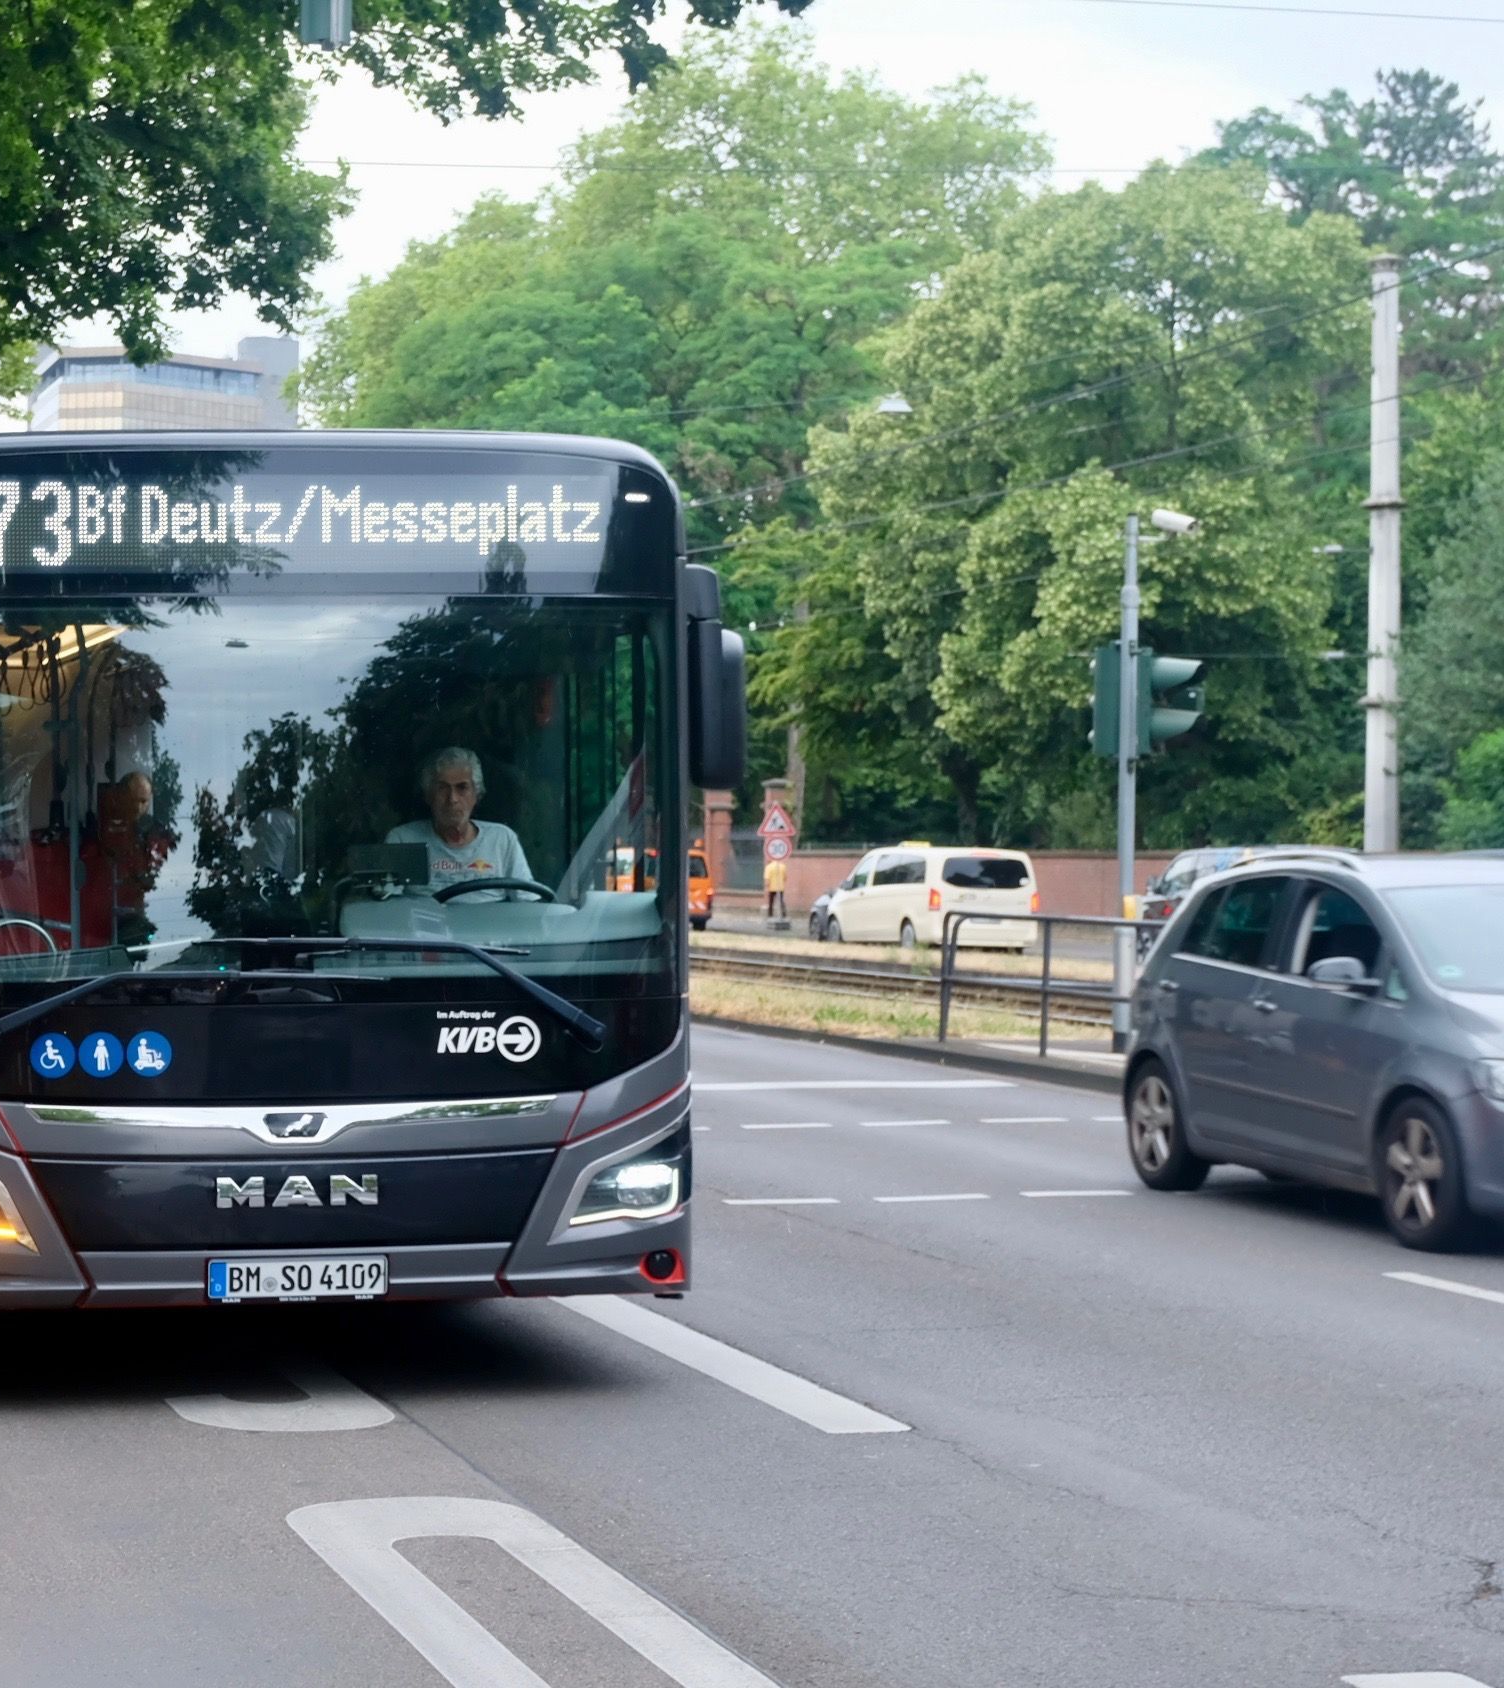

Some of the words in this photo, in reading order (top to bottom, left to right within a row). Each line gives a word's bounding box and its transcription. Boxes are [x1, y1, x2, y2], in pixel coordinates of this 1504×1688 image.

[78, 485, 127, 544] Bf
[141, 484, 600, 556] Deutz/Messeplatz
[437, 1010, 448, 1019] Im
[449, 1010, 481, 1021] Auftrag
[481, 1010, 496, 1019] der
[437, 1026, 497, 1054] KVB
[216, 1174, 379, 1208] MAN
[229, 1266, 261, 1293] BM
[281, 1264, 312, 1292] SO
[319, 1263, 382, 1291] 4109
